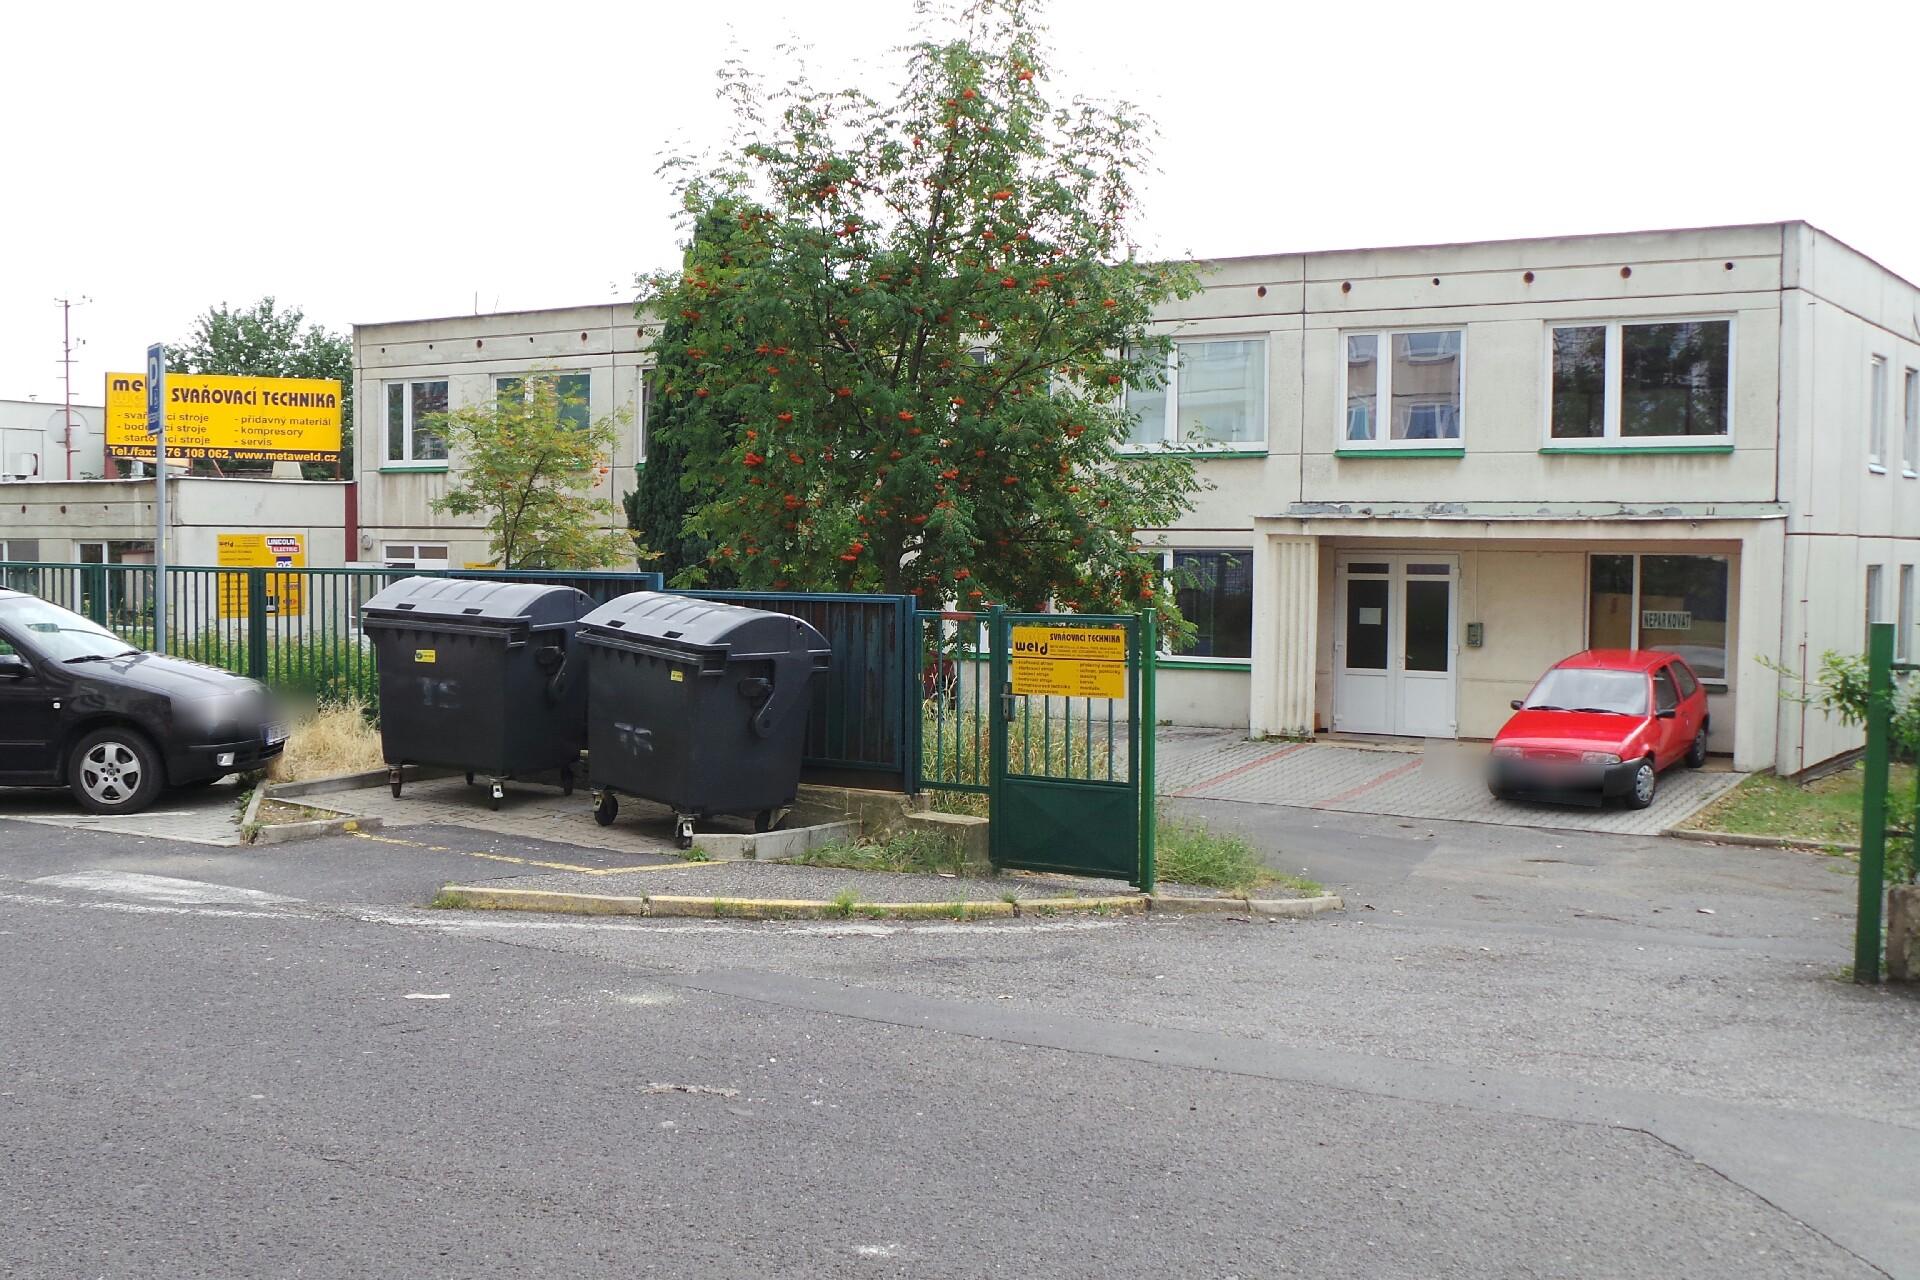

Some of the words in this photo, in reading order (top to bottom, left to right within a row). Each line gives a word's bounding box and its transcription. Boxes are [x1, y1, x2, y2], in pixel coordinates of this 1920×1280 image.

[149, 356, 158, 406] P
[171, 384, 257, 406] SVAŘOVACÍ
[262, 391, 336, 409] TECHNIKA
[179, 413, 209, 424] stroje
[177, 424, 207, 434] stroje
[241, 426, 304, 438] kompresory
[180, 435, 211, 446] stroje
[241, 438, 273, 446] servis
[110, 446, 157, 457] Tel./fax:
[163, 448, 181, 458] 76
[184, 449, 206, 458] 108
[234, 452, 337, 463] www.metaweld.cz
[1049, 631, 1086, 642] SVAŘOVACÍ
[1088, 635, 1121, 644] TECHNIKA
[1015, 642, 1048, 655] weld
